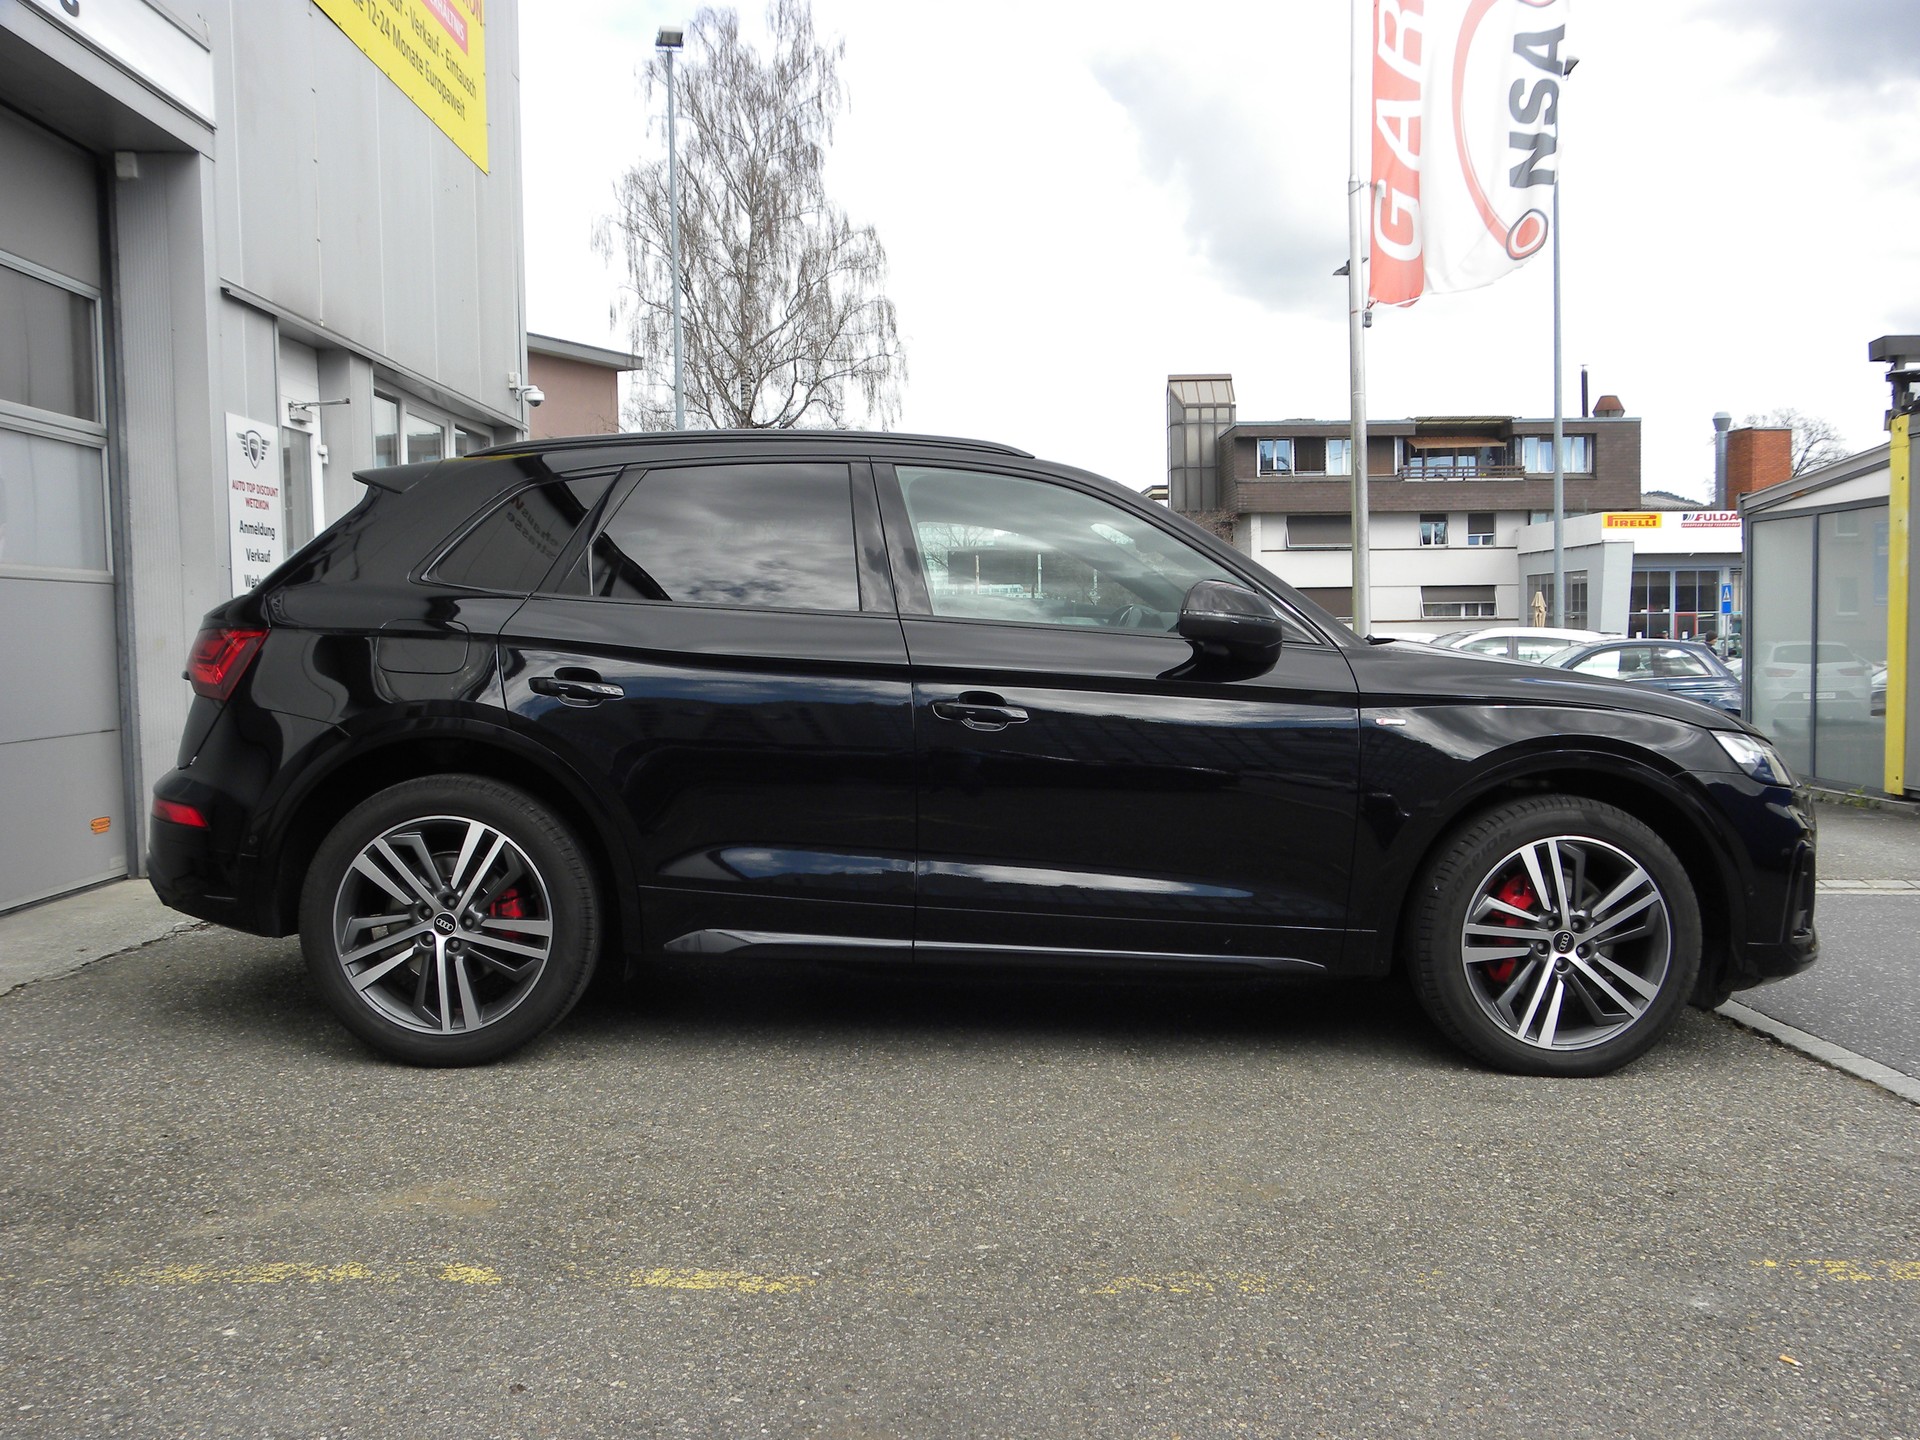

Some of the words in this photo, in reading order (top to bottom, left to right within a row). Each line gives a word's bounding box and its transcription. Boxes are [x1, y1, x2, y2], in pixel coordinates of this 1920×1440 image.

[367, 0, 390, 41] 12-24
[392, 23, 424, 76] Monate
[425, 59, 466, 122] Europaweit
[410, 6, 440, 58] Verkauf
[446, 48, 476, 101] Eintausch
[232, 479, 245, 491] AUTO
[246, 481, 256, 493] TOP
[256, 484, 279, 498] DISCOUNT
[239, 519, 275, 540] Anmeldung
[1607, 514, 1657, 527] PIRELLI
[1694, 513, 1739, 521] FULDA
[245, 547, 270, 563] Verkauf
